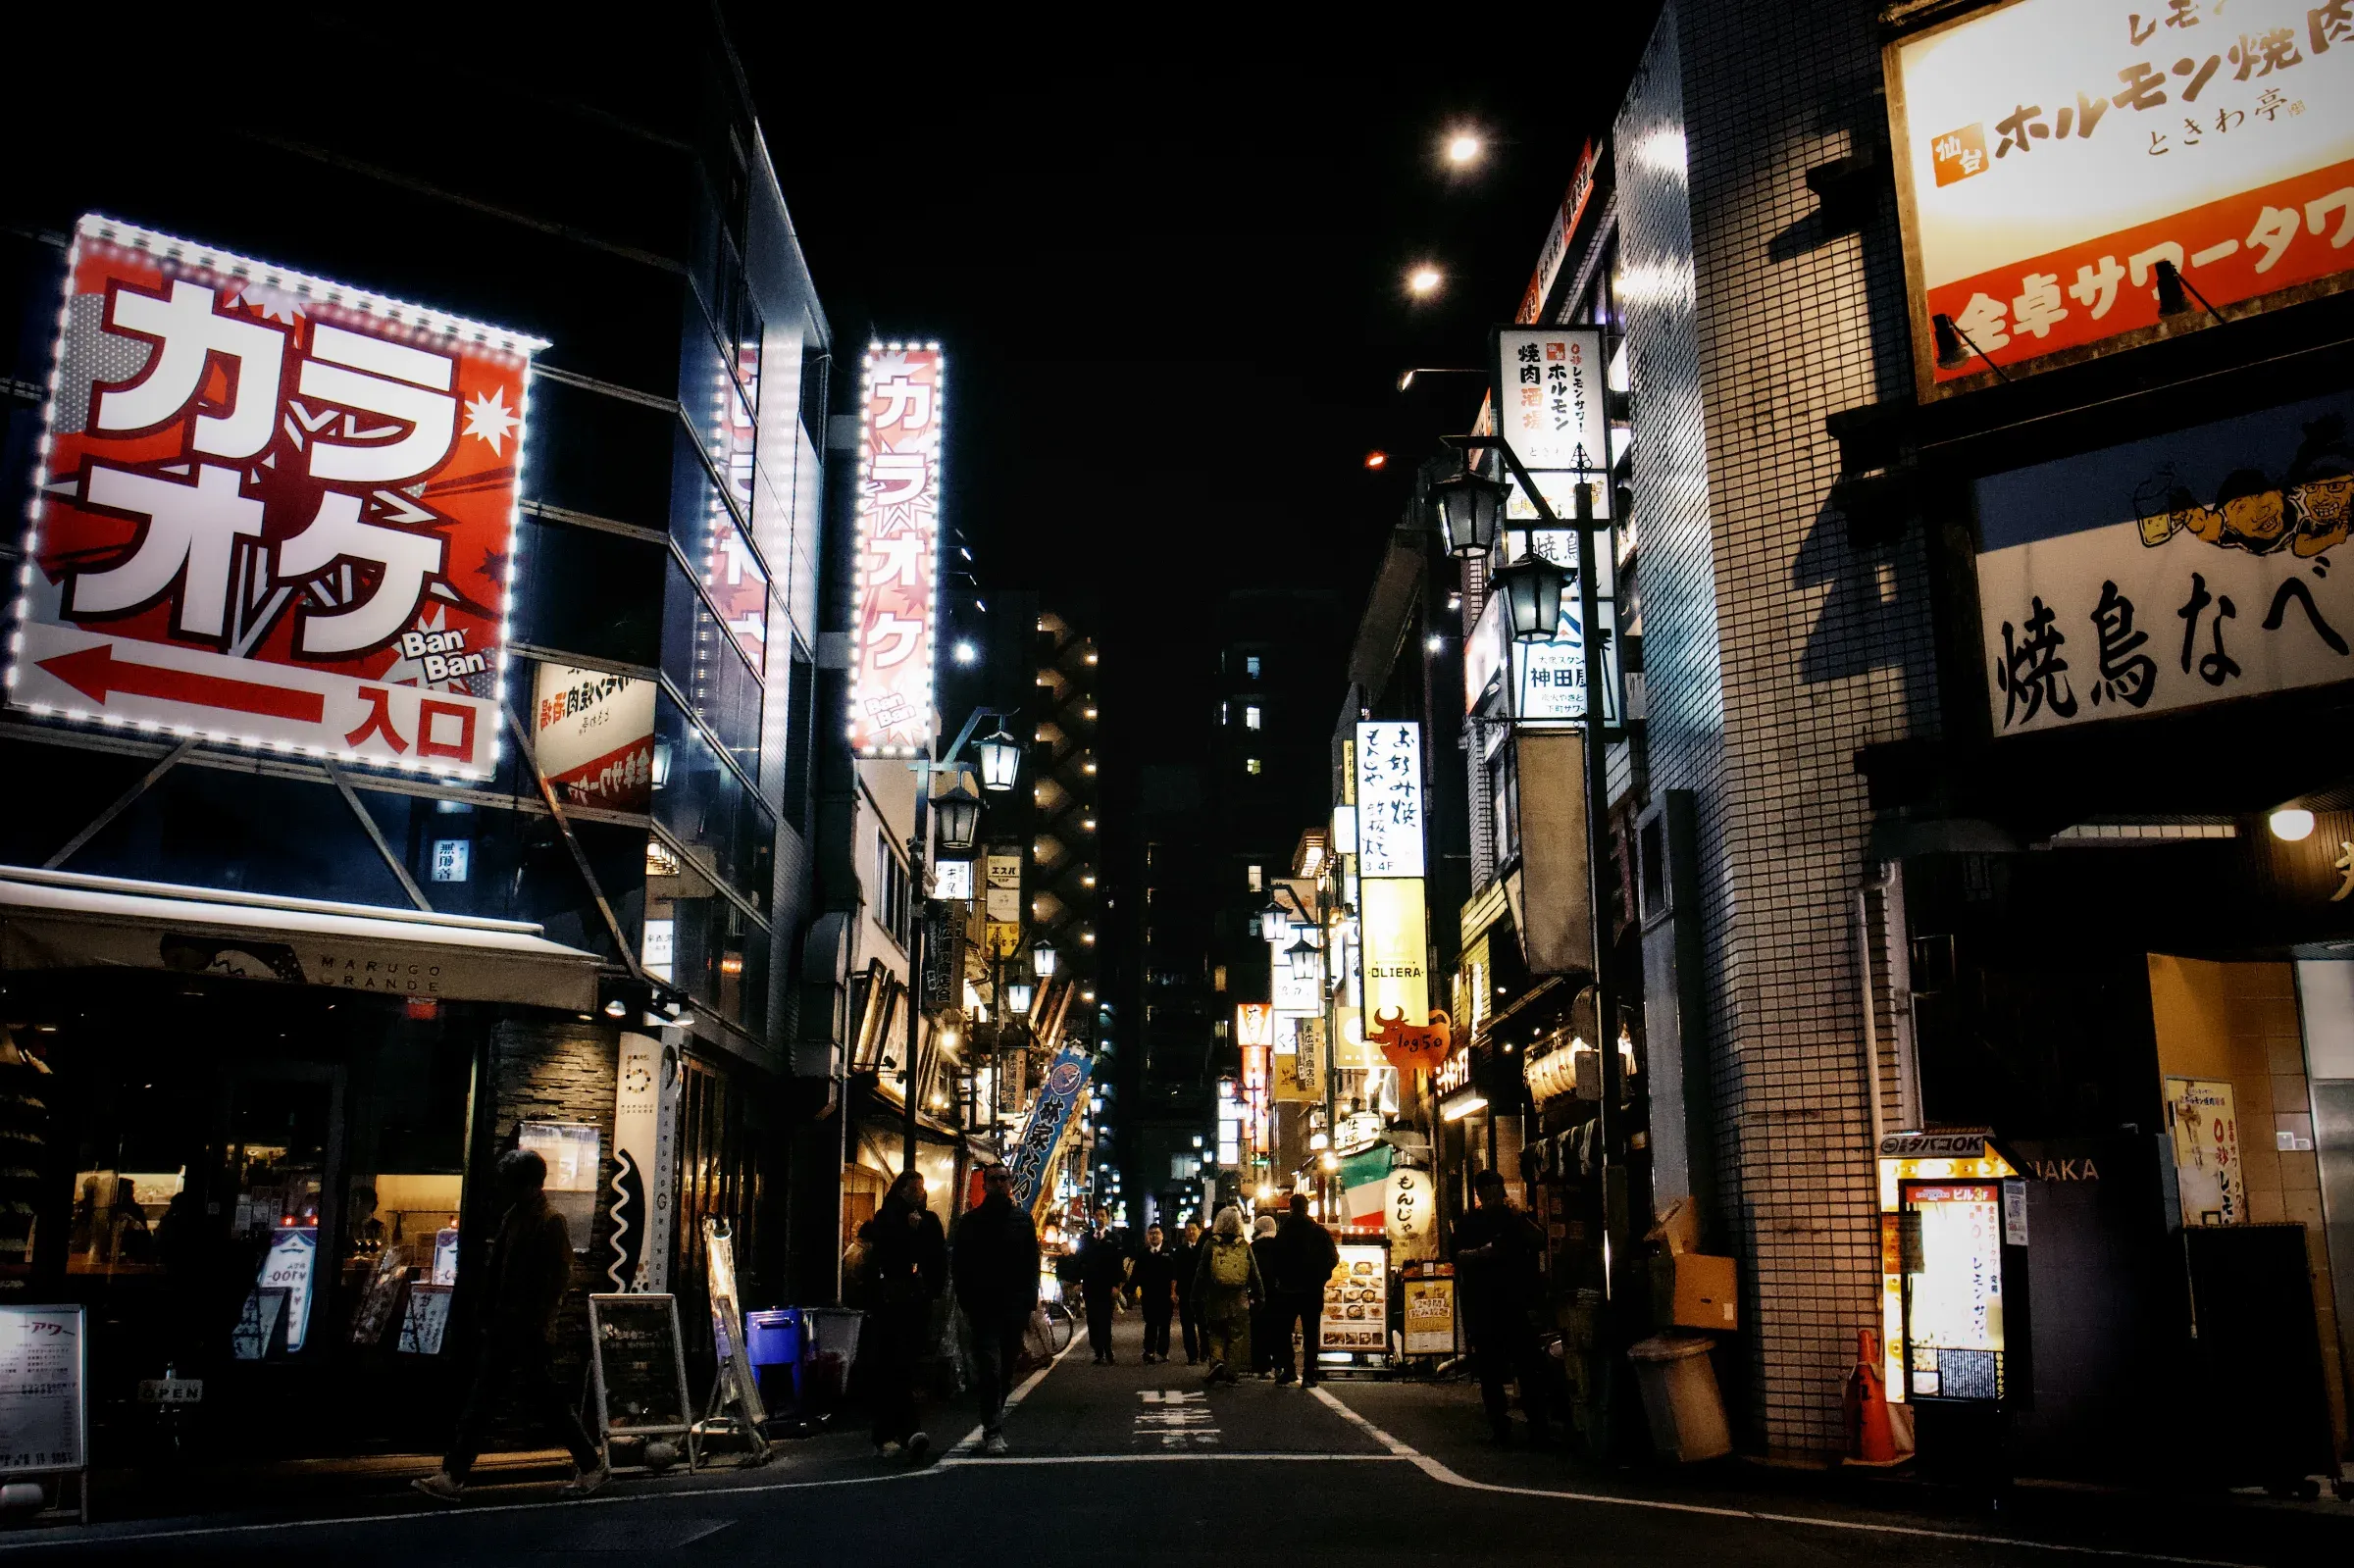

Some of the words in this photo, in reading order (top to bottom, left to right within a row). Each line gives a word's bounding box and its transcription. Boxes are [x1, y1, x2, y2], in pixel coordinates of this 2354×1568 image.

[2128, 0, 2225, 46] レモ
[2148, 87, 2288, 156] ときわ亭
[1935, 135, 1983, 175] 仙台
[1517, 342, 1545, 432] 焼肉酒場
[1548, 363, 1569, 431] ホルモン
[1529, 444, 1575, 458] ときわ
[864, 375, 932, 669] カラオケ
[402, 627, 465, 661] Ban
[1538, 655, 1586, 665] 大衆スタン
[1997, 556, 2350, 731] 焼鳥なべ
[425, 650, 486, 683] Ban
[345, 684, 478, 765] 入口
[864, 692, 904, 717] Ban
[877, 702, 919, 731] Ban
[1546, 704, 1586, 714] 下町サワ
[1385, 725, 1417, 828] お好み焼
[321, 954, 442, 977] MARUGO
[1395, 1176, 1416, 1235] もんじゃ
[142, 1386, 199, 1399] OPEN
